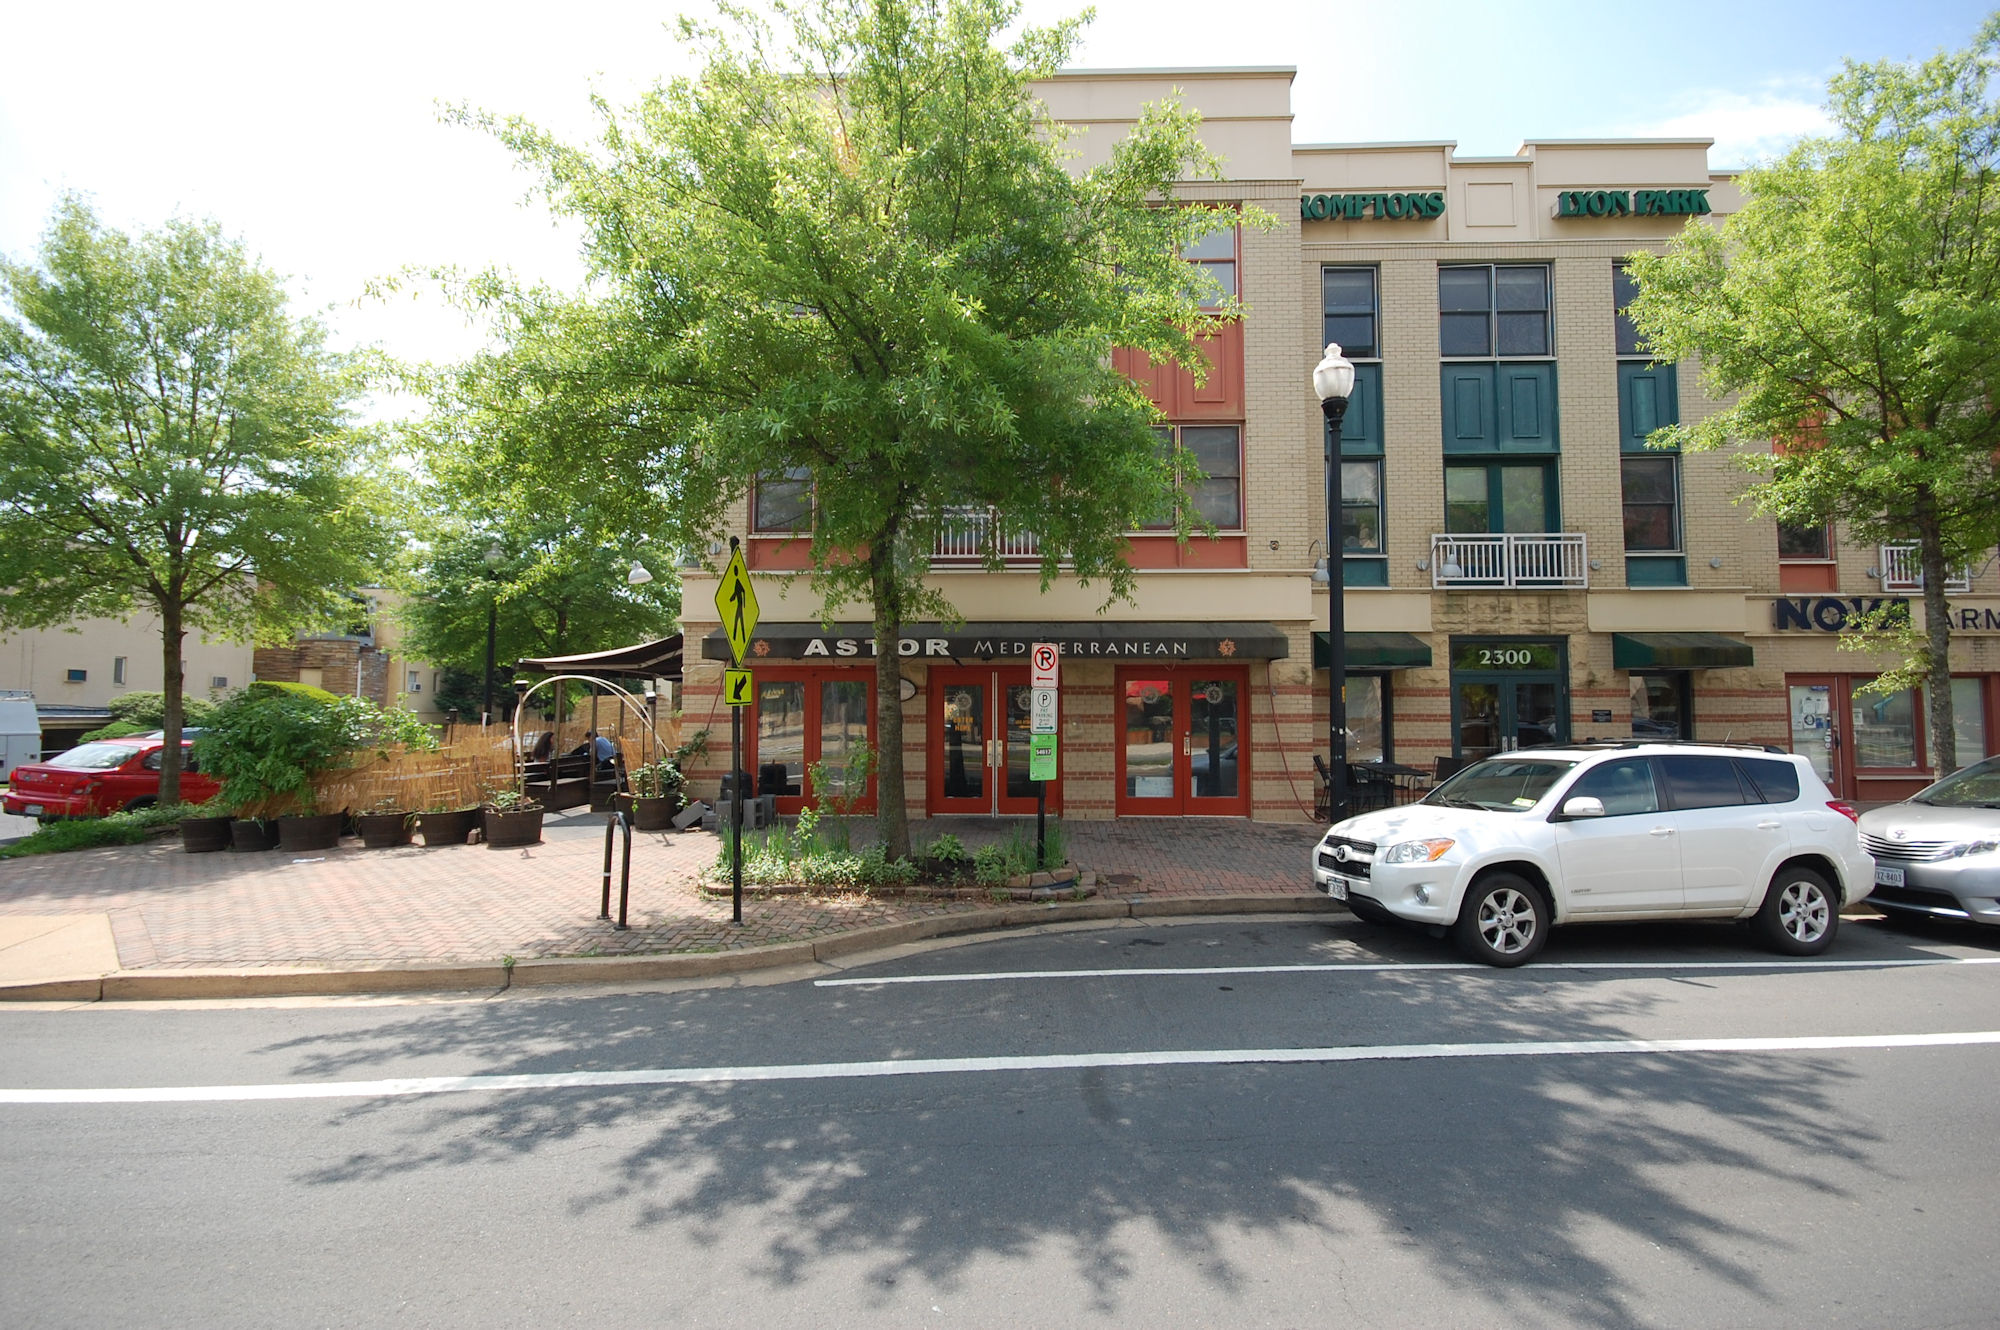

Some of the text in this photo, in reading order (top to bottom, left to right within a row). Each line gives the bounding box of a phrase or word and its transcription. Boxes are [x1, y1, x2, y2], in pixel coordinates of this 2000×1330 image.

[1557, 189, 1712, 217] LYON PARK
[1776, 598, 1910, 631] NOVA
[803, 639, 1188, 656] ASTOR MEDERRANEAN
[1479, 649, 1532, 665] 2300
